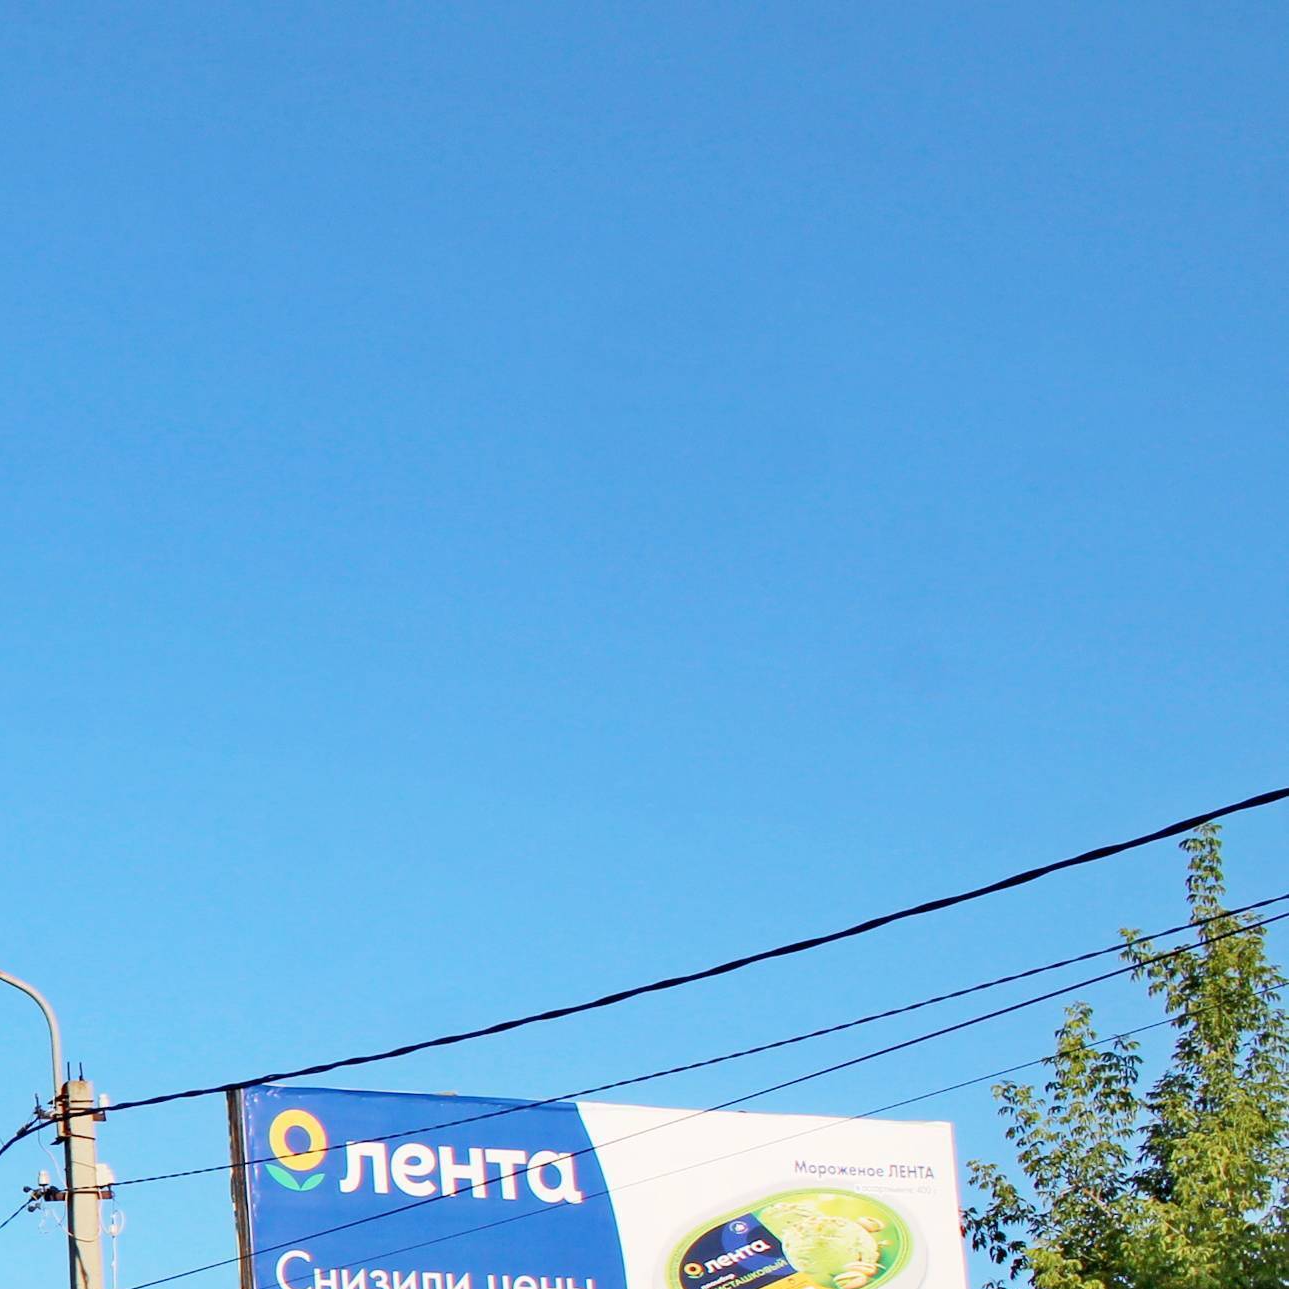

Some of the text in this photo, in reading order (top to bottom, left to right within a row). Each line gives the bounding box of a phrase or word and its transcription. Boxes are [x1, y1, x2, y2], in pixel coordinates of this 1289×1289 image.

[339, 1140, 583, 1205] лента
[794, 1160, 935, 1180] Мороженое ЛЕНТА
[703, 1239, 771, 1274] лента
